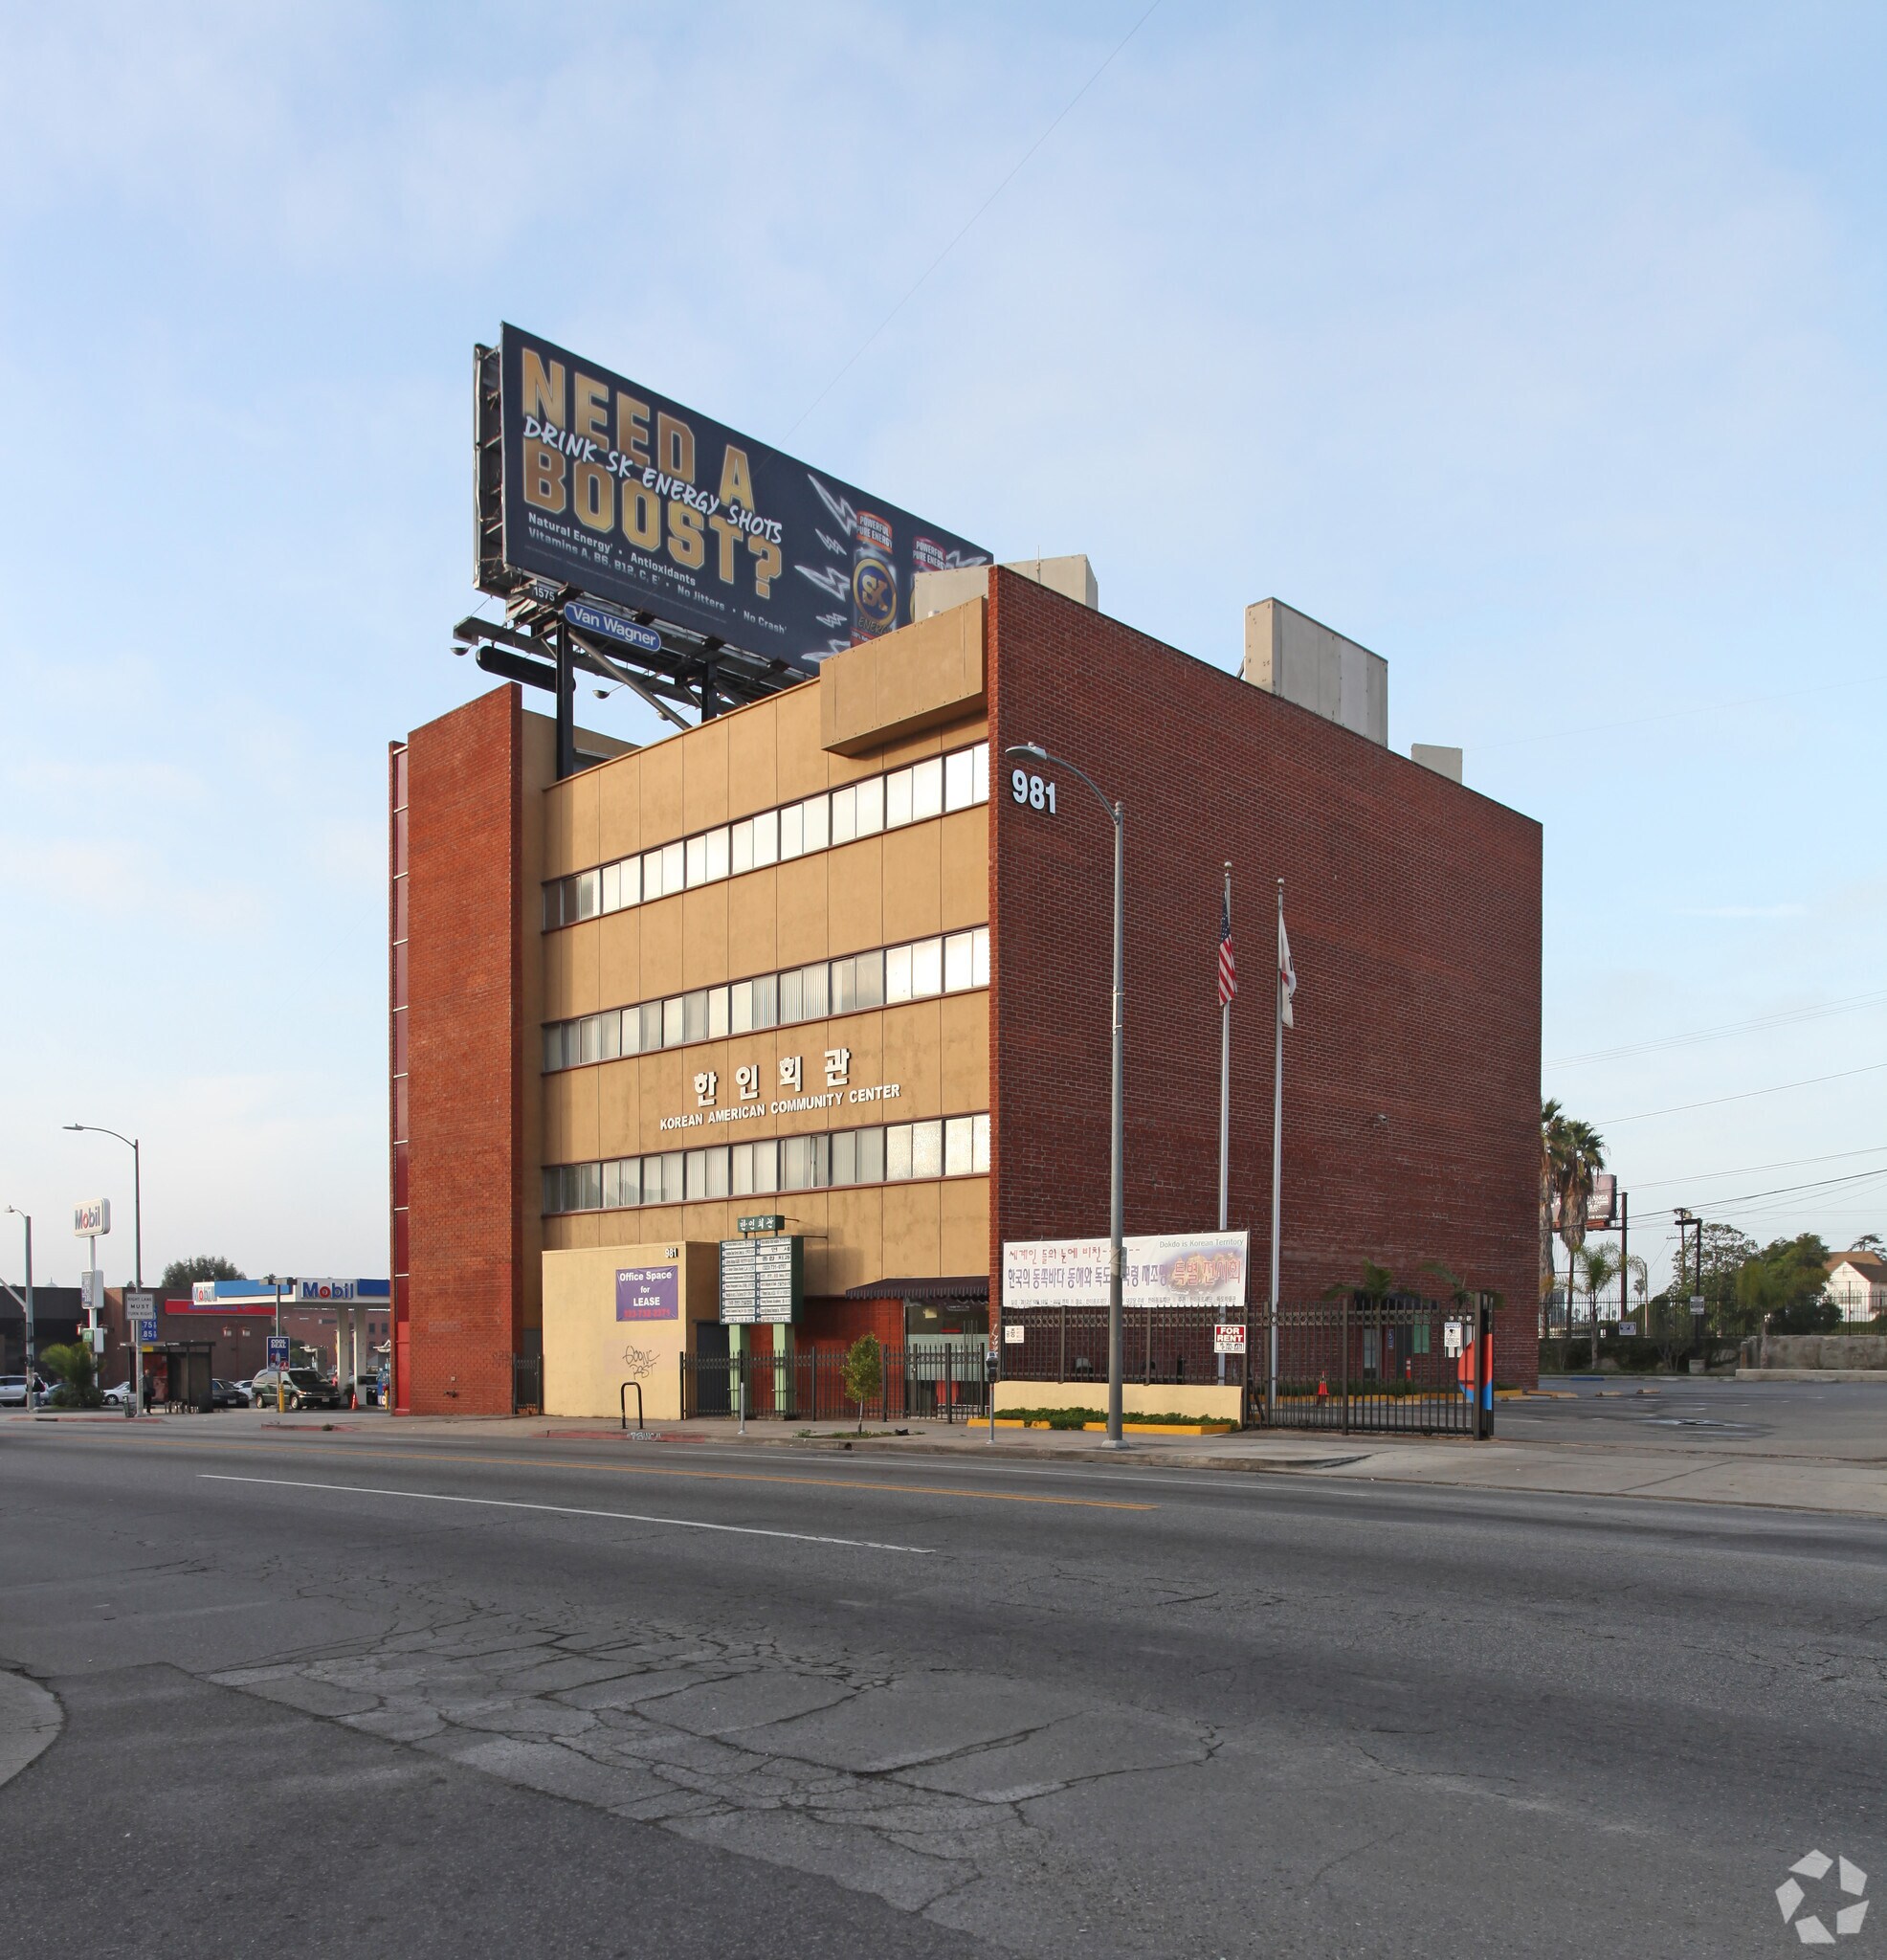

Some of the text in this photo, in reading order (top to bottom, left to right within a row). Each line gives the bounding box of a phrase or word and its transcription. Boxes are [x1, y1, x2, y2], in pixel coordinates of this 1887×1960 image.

[522, 347, 755, 514] NEED A
[523, 415, 783, 544] DRINK SK ENERGY SHOTS
[523, 438, 782, 600] BOOST?
[859, 515, 890, 537] POWERFUL
[857, 525, 893, 548] PURE ENERGY
[528, 512, 570, 538] Natural
[631, 552, 696, 586] Antioxidants
[913, 549, 927, 563] PURE
[916, 540, 944, 561] POWERFUL
[528, 527, 578, 554] Vitamins
[677, 585, 690, 597] No
[693, 592, 725, 611] Jitters
[744, 611, 756, 623] No
[534, 587, 555, 602] 1575
[862, 575, 888, 612] SK
[573, 607, 655, 645] Van Wagner
[1012, 769, 1055, 814] 981
[660, 1084, 900, 1130] KOREAN AMERICAN COMMUNITY CENTER
[75, 1206, 100, 1231] Mobil
[664, 1248, 677, 1258] 981
[1159, 1240, 1180, 1249] Dokdo
[1215, 1237, 1244, 1247] Territory
[620, 1271, 672, 1281] Office Space
[1008, 1268, 1031, 1289] 한국의
[193, 1285, 216, 1302] Mobil
[301, 1281, 354, 1299] Mobil
[633, 1297, 660, 1306] LEASE
